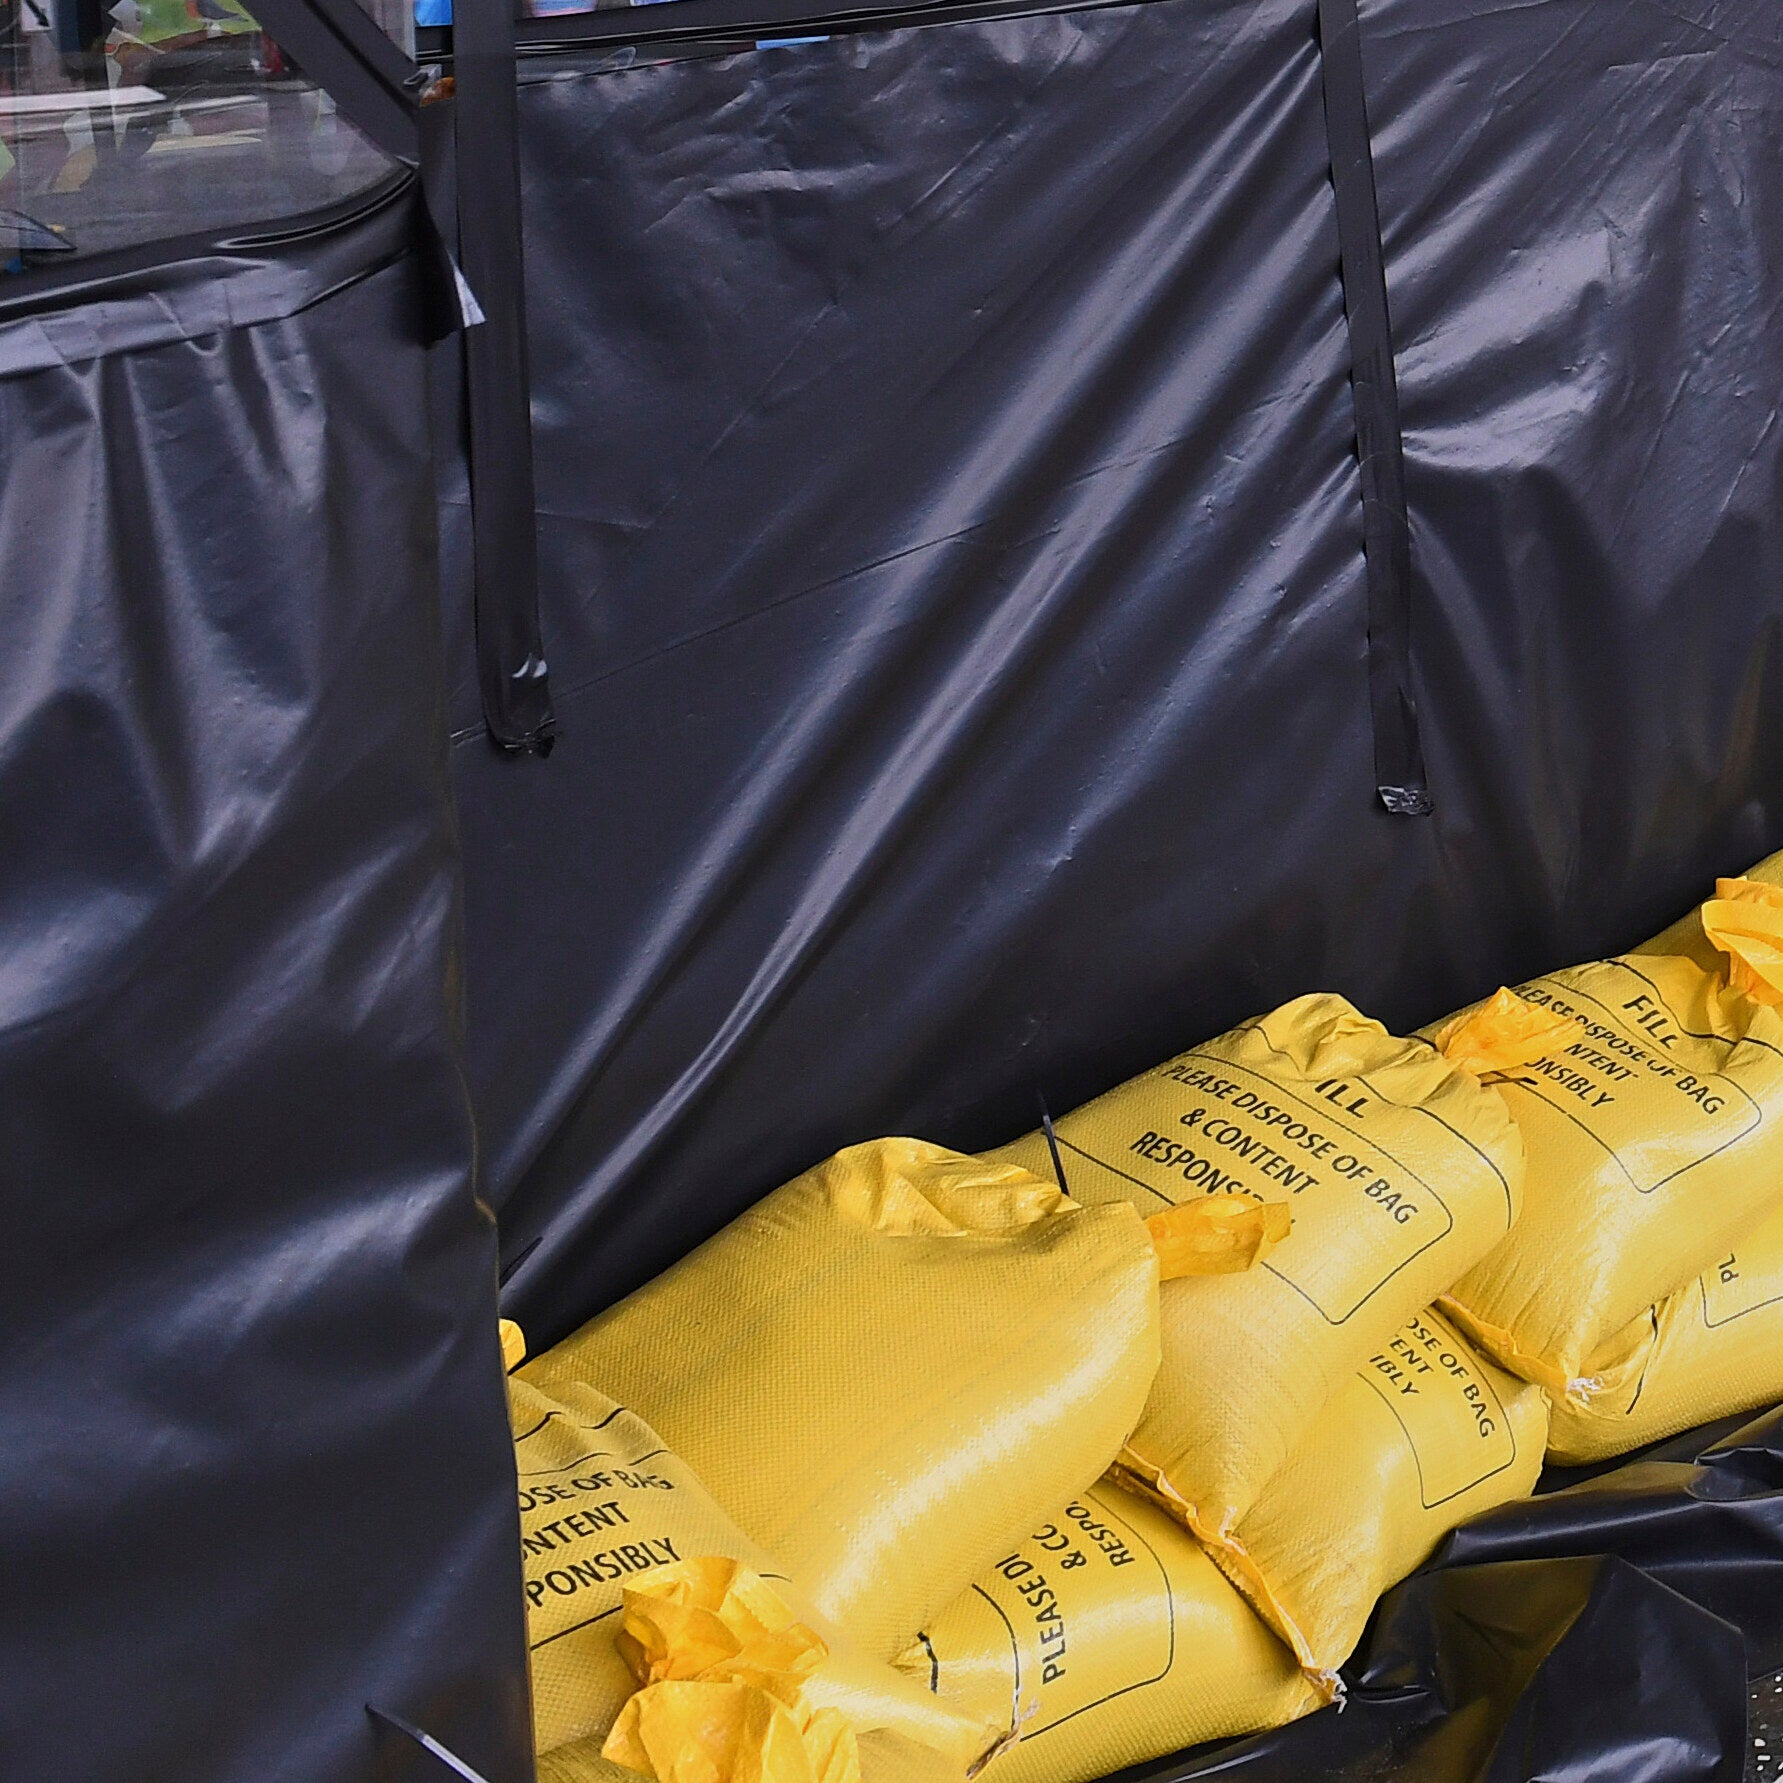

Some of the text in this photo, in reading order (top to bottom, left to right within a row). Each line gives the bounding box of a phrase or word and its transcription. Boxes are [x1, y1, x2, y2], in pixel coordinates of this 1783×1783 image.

[1622, 993, 1680, 1050] FILL
[1523, 1056, 1616, 1108] ONSIBLY
[1562, 1042, 1640, 1082] NTENT
[1574, 1013, 1648, 1063] DISPOSE
[1675, 1075, 1726, 1115] BAG
[1314, 1078, 1370, 1120] ILL
[1129, 1130, 1265, 1203] RESPONS
[1161, 1064, 1420, 1225] PLEASE DISPOSE OF BAG
[1180, 1108, 1321, 1195] & CONTENT
[1438, 1352, 1496, 1438] OF BAG
[571, 1469, 675, 1491] OF BAG
[522, 1501, 631, 1561] NTENT
[1060, 1550, 1087, 1570] &
[526, 1536, 683, 1608] PONSIBLY
[1016, 1574, 1067, 1685] PLEASE
